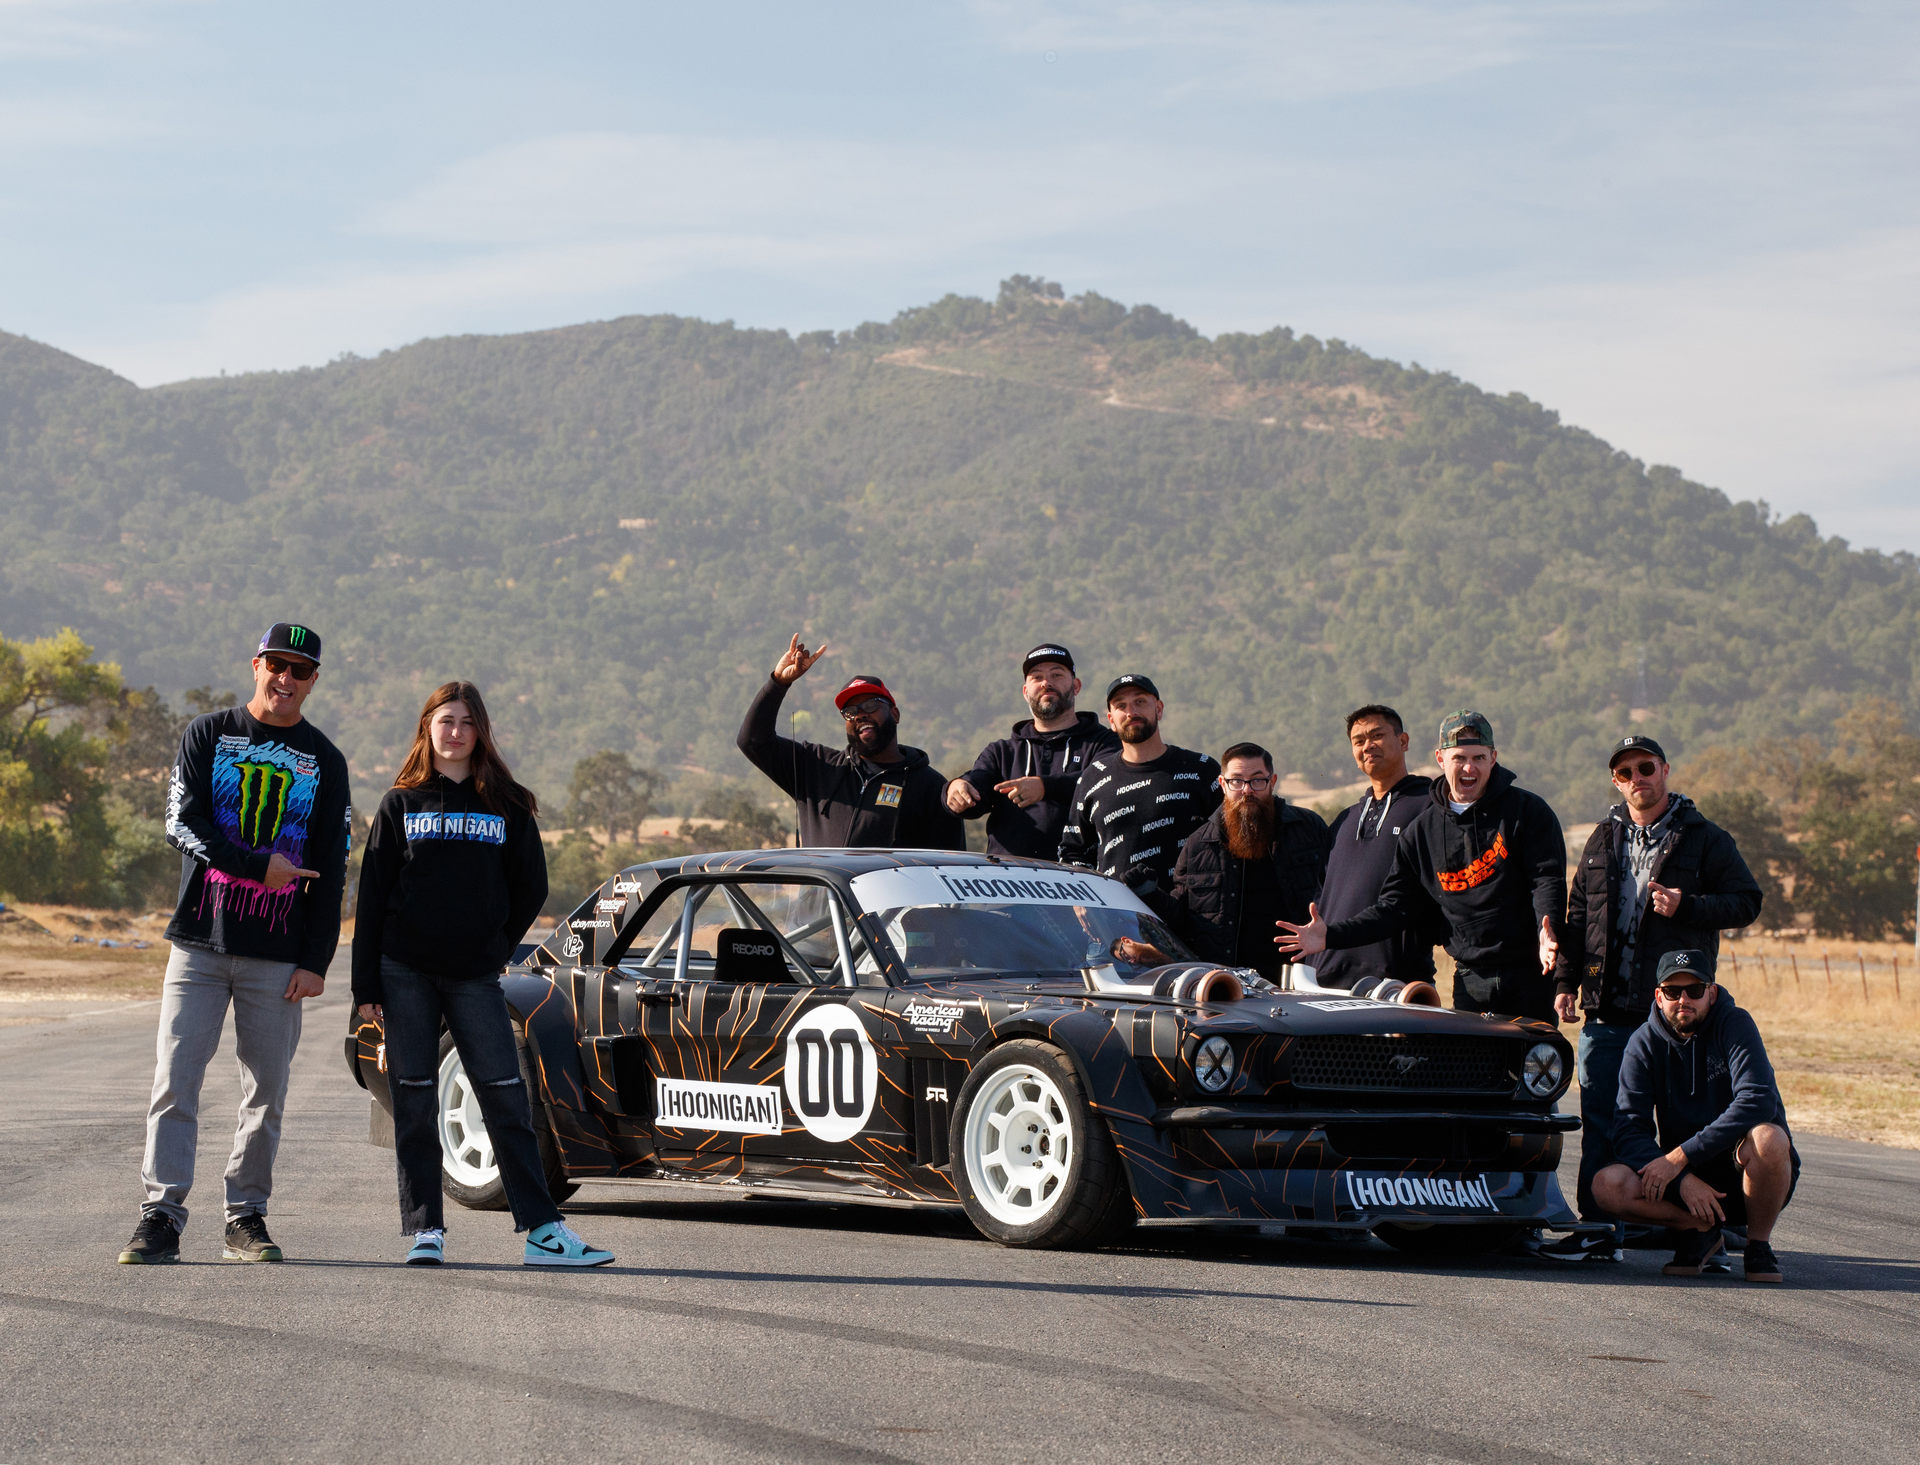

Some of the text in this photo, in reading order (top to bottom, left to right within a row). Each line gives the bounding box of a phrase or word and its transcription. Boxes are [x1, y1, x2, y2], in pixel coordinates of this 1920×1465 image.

[1116, 779, 1151, 796] HOONIGAN
[1156, 792, 1190, 804] HOONIGAN
[1103, 805, 1136, 825] HOONIGAN
[1142, 817, 1175, 834] HOONIGAN
[1130, 846, 1161, 864] HOONIGAN
[732, 943, 775, 956] RECARO
[902, 1001, 964, 1018] American
[910, 1014, 955, 1033] Racing
[795, 1028, 864, 1118] 00
